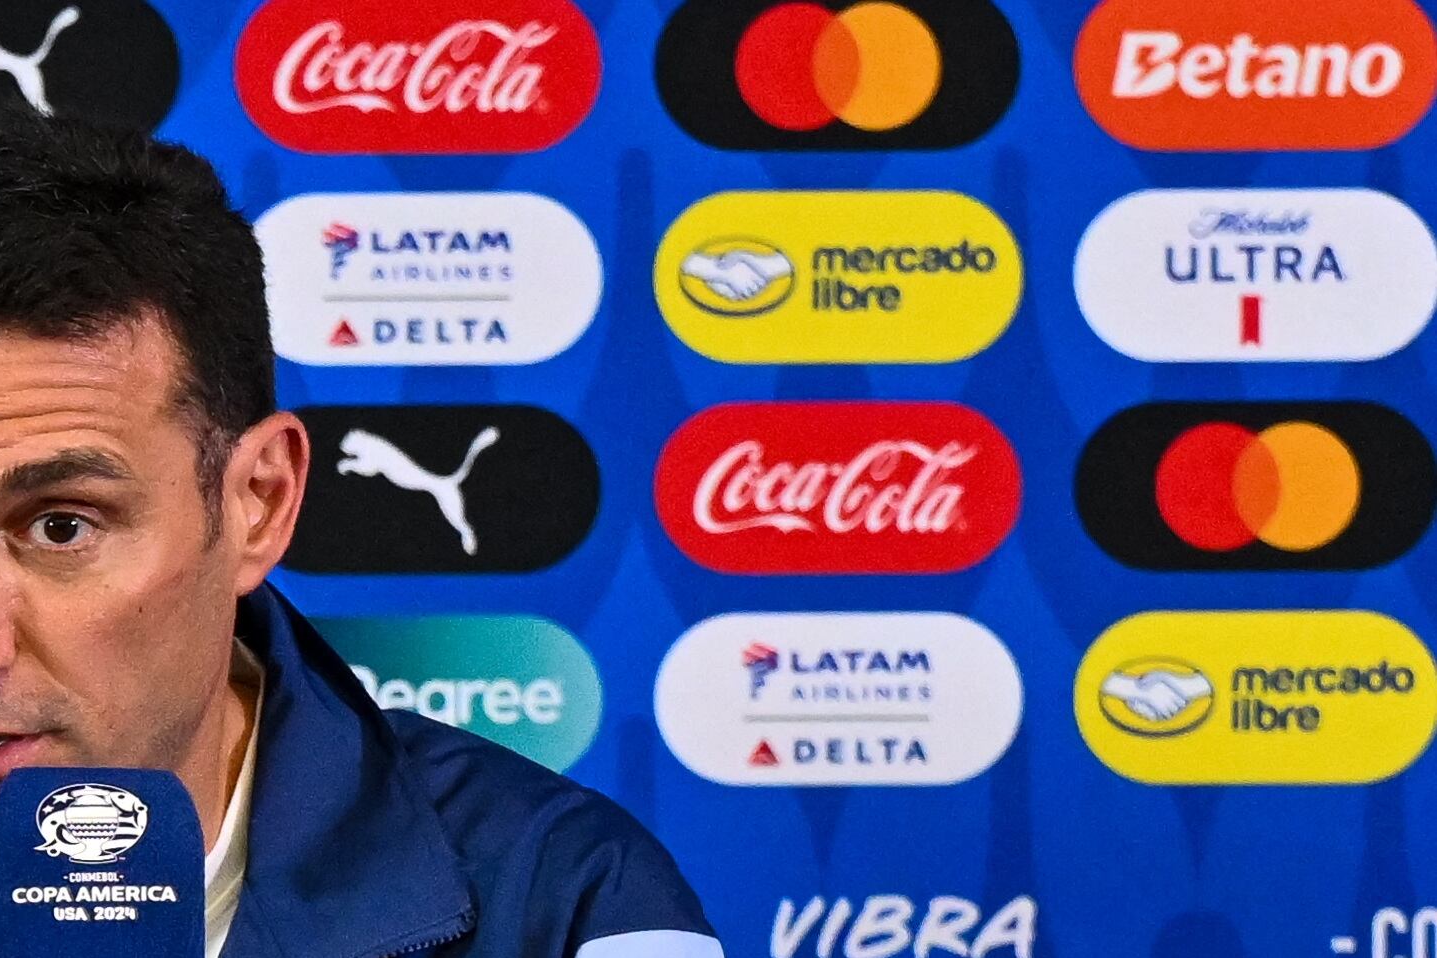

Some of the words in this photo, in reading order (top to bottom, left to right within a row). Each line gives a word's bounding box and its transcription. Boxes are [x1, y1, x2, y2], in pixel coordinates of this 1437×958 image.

[273, 20, 556, 113] Coca-Cola
[1113, 31, 1403, 98] Betano
[372, 231, 510, 253] LATAM
[812, 240, 997, 273] mercado
[371, 265, 512, 281] AIRLINES
[1166, 245, 1342, 282] ULTRA
[812, 278, 901, 311] libre
[373, 319, 506, 344] DELTA
[693, 440, 976, 533] Coca-Cola
[791, 651, 930, 673] LATAM
[1232, 661, 1415, 694] mercado
[792, 684, 931, 701] AIRLINES
[1232, 699, 1320, 732] libre
[794, 739, 927, 764] DELTA
[12, 887, 73, 903] COPA
[75, 886, 176, 902] AMERICA
[53, 907, 88, 921] USA
[93, 906, 136, 921] 2024
